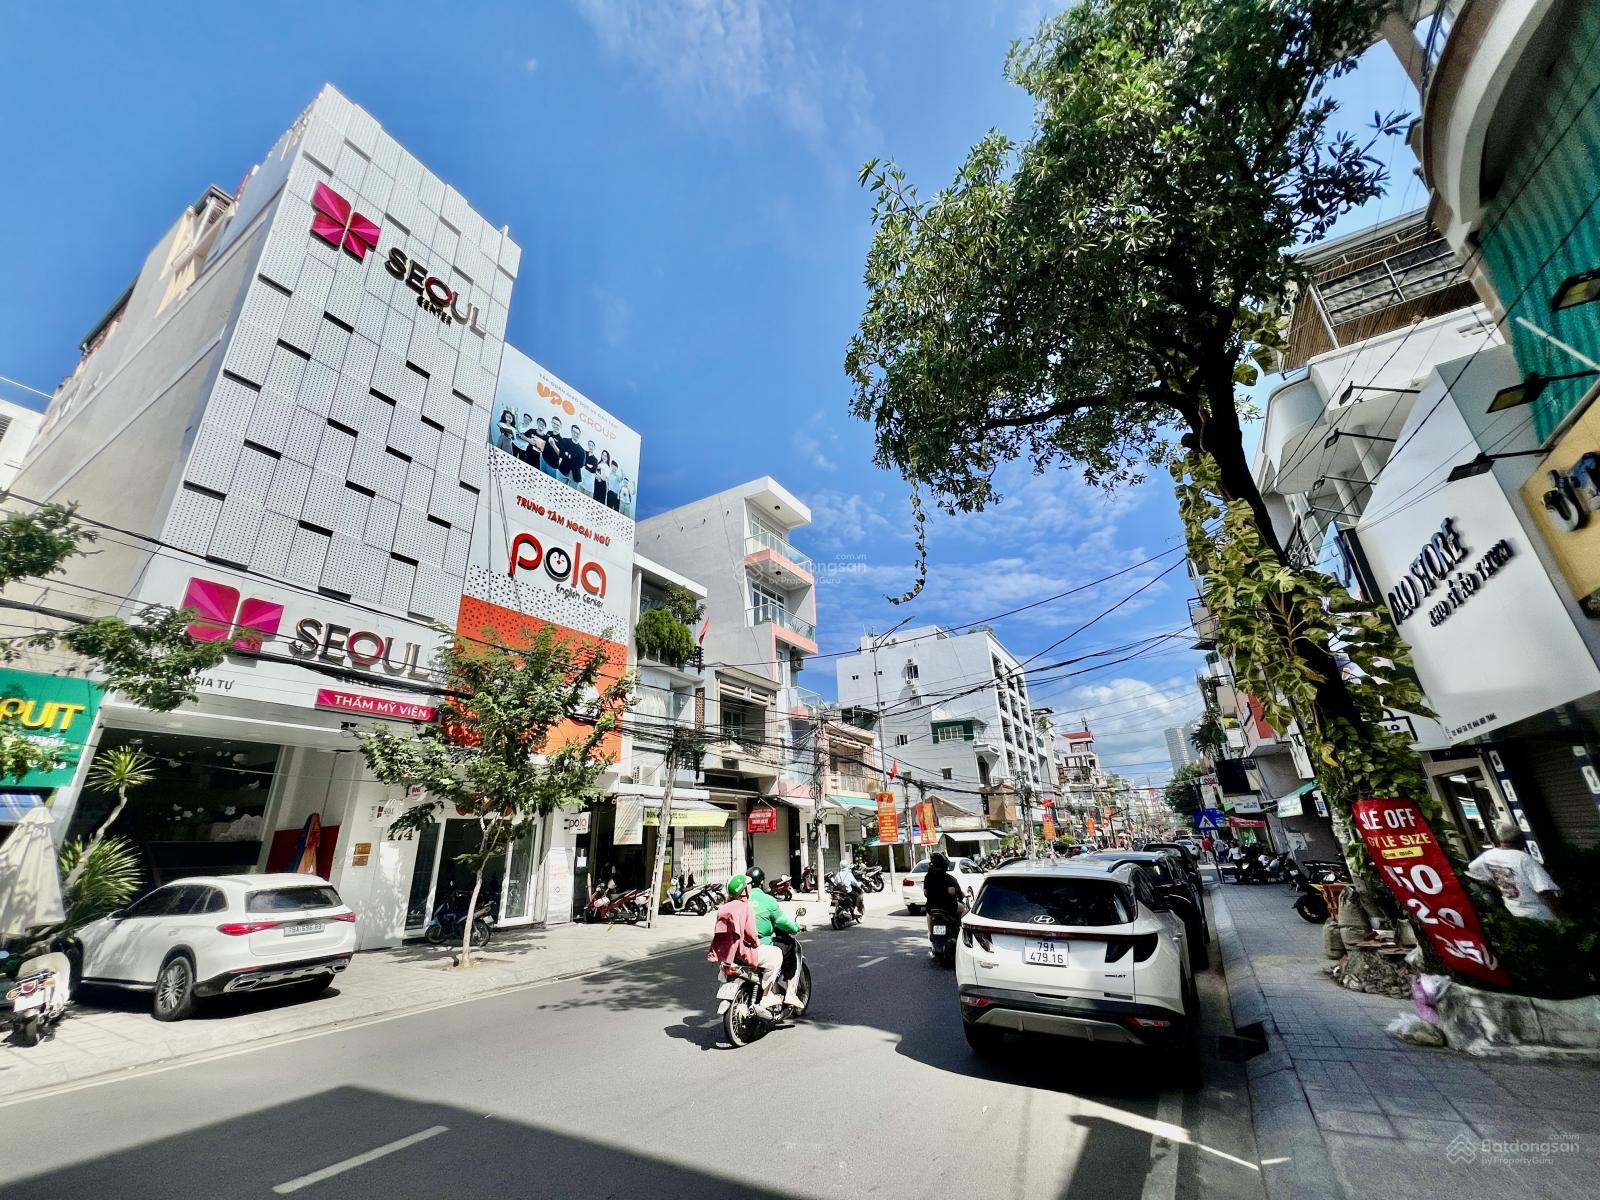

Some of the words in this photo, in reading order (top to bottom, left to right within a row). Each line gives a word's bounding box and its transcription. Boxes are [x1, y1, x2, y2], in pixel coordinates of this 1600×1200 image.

[384, 247, 487, 340] SEOUL
[416, 295, 452, 327] CENTER
[579, 412, 617, 440] GROUP
[516, 494, 546, 516] TRUNG
[547, 509, 565, 526] TÂM
[566, 519, 593, 539] NGOẠI
[594, 530, 612, 547] NGỮ
[507, 532, 608, 599] pola
[1408, 517, 1469, 599] STORE
[556, 583, 581, 600] English
[583, 593, 604, 608] Center
[288, 617, 431, 683] SEOUL
[195, 675, 214, 689] GIA
[215, 678, 236, 692] TỰ
[334, 693, 374, 711] THẨM
[376, 699, 397, 714] MỸ
[399, 704, 428, 719] VIỆN
[1384, 808, 1417, 829] OFF
[1399, 832, 1432, 846] SIZE
[1029, 951, 1064, 964] 479.16
[1037, 941, 1055, 952] 79A
